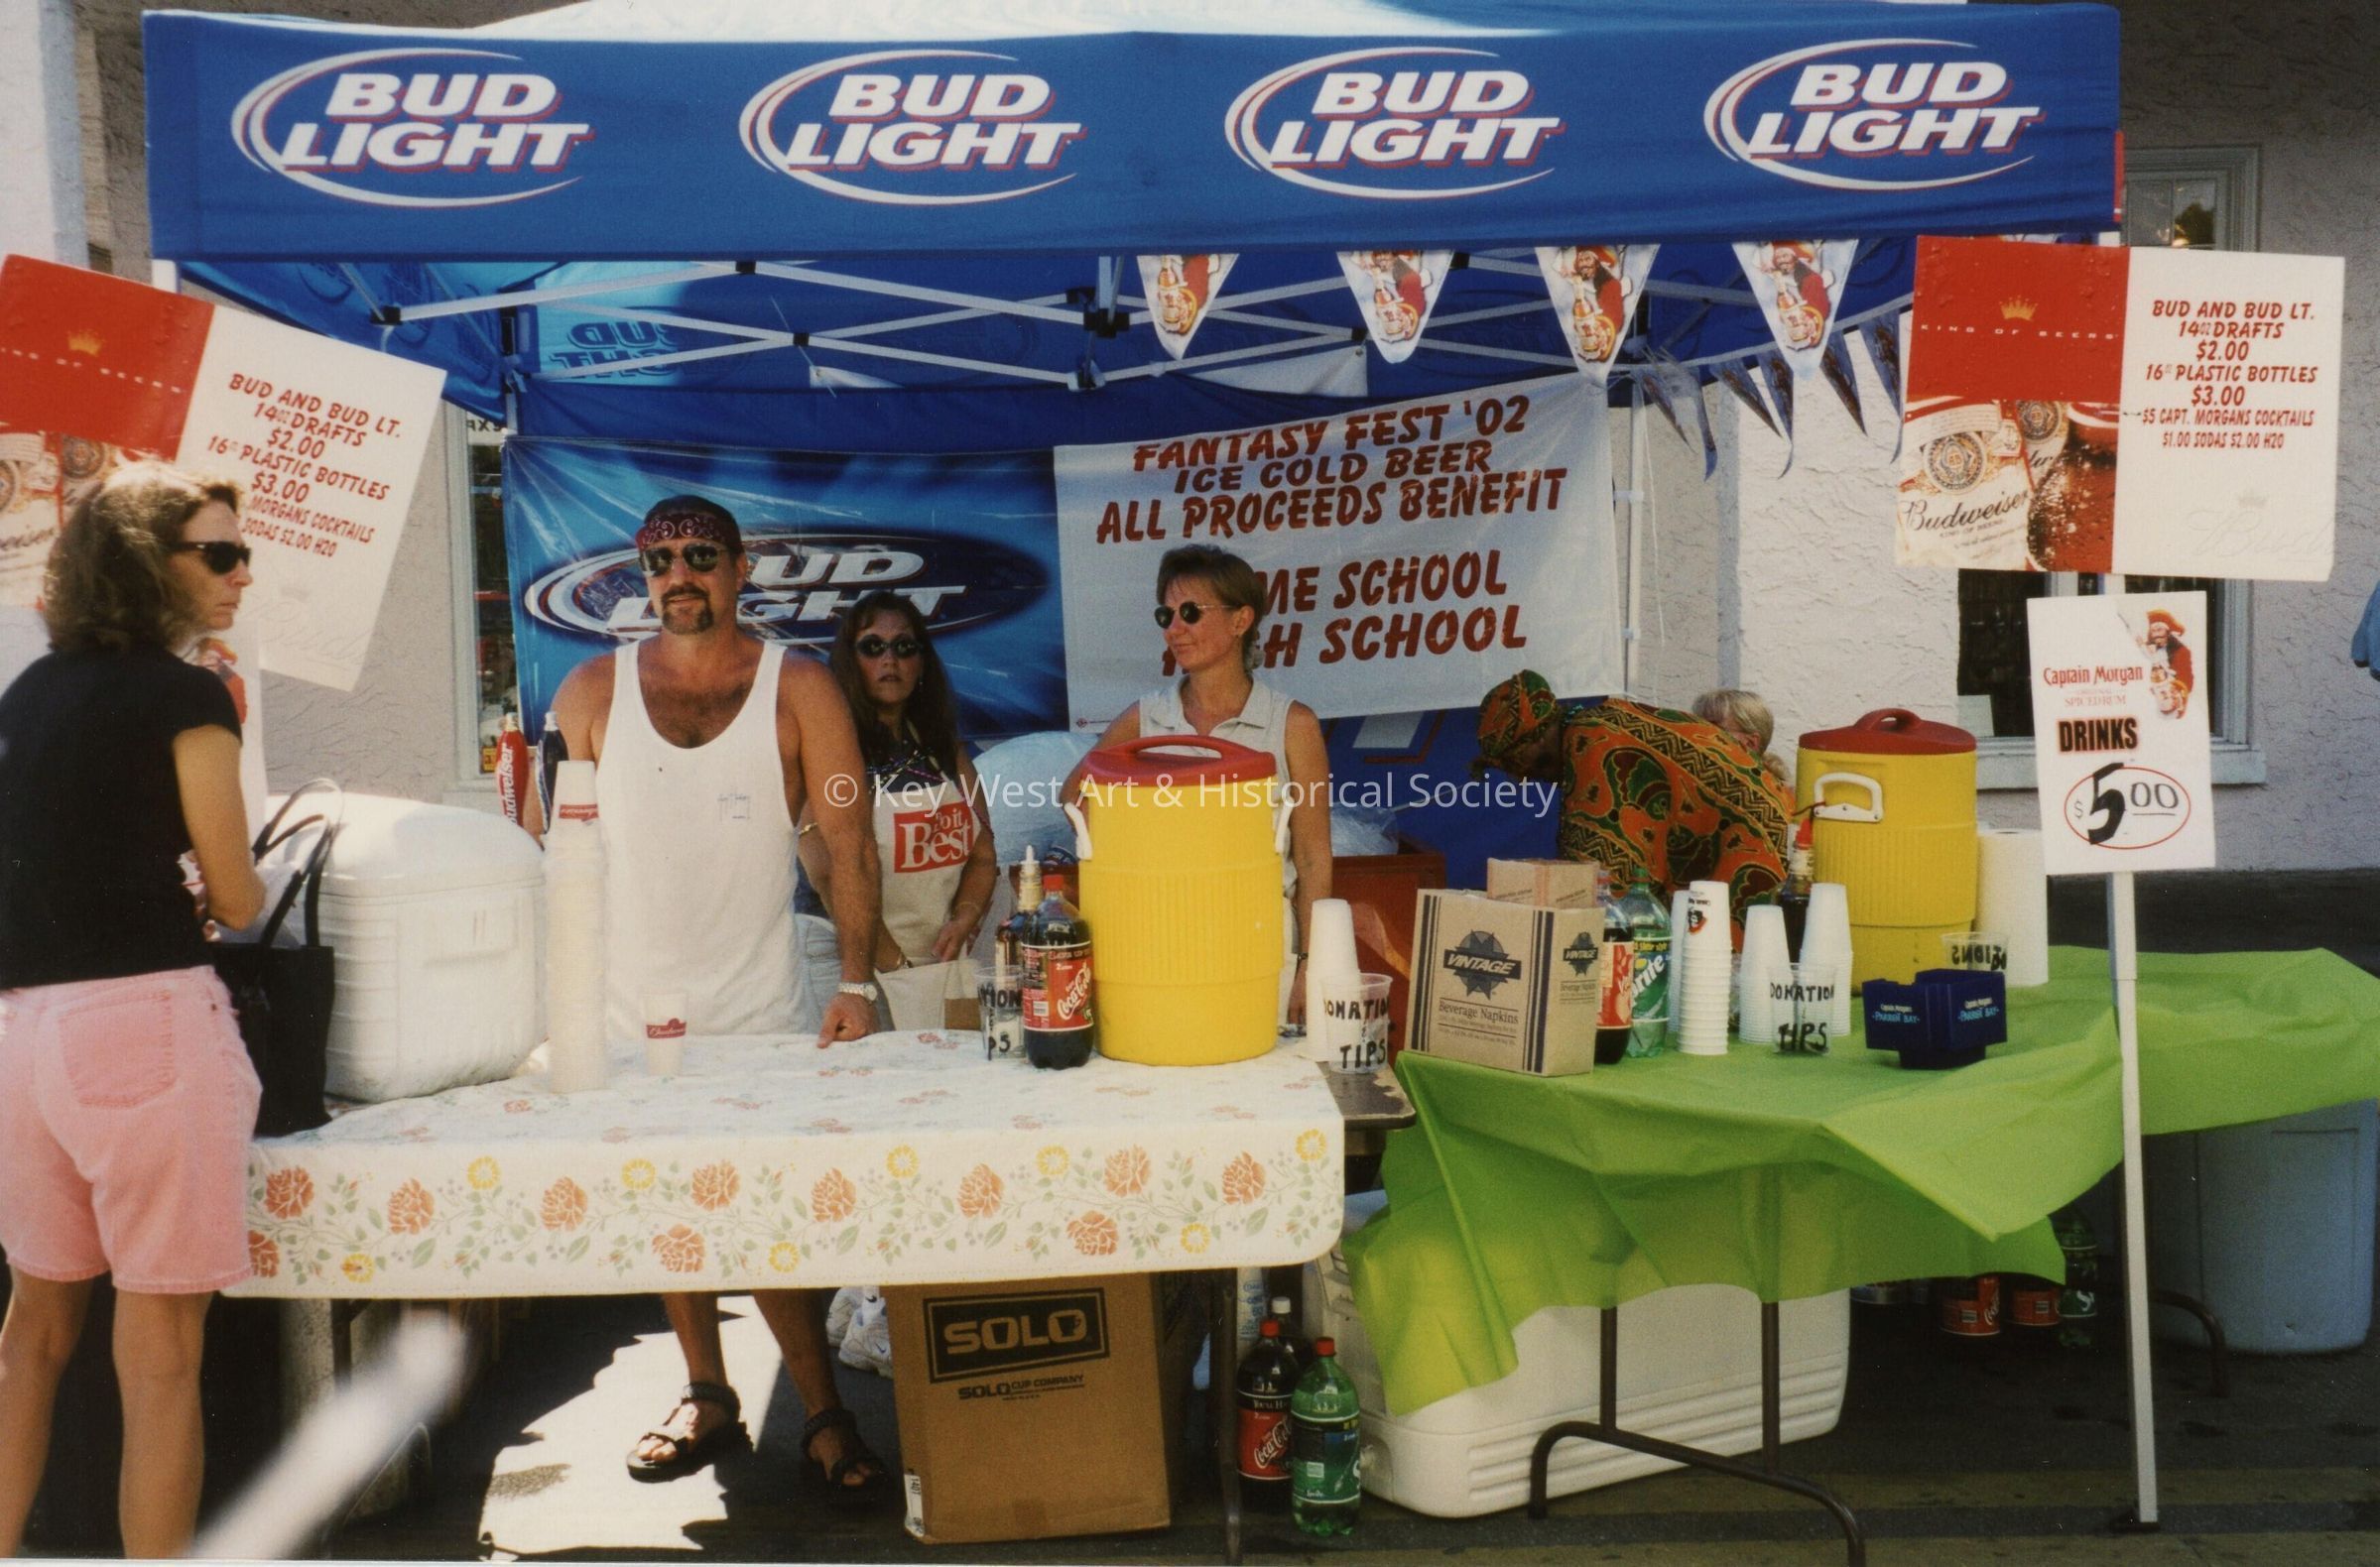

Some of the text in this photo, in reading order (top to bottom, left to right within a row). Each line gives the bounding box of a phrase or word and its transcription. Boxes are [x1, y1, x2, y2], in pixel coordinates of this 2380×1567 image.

[325, 73, 562, 118] BUD
[828, 74, 1054, 119] BUD
[1312, 70, 1533, 118] BUD
[1790, 60, 2012, 108] BUD
[281, 122, 595, 174] LIGHT
[787, 122, 1086, 171] LIGHT
[1270, 117, 1563, 169] LIGHT
[1749, 106, 2046, 160] LIGHT
[2153, 300, 2316, 320] BUD AND BUD LT.
[2213, 321, 2285, 339] DRAFTS
[2195, 339, 2250, 361] $2.00
[2175, 365, 2242, 382] PLASTIC
[2247, 366, 2318, 383] BOTTLES
[2191, 384, 2246, 407] $3.00
[229, 373, 401, 438] BUD AND BUD LT.
[2143, 409, 2315, 426] $5 CAPT. MORGANS COCKTAILS
[267, 426, 325, 460] $2.00
[291, 414, 368, 447] DRAFTS
[1133, 395, 1531, 472] FANTASY FEST '02
[2163, 431, 2191, 448] $1.00
[2193, 432, 2228, 448] SODAS
[2230, 432, 2260, 449] $2.00
[239, 444, 312, 479] PLASTIC
[314, 466, 391, 502] BOTTLES
[250, 471, 311, 505] $3.00
[1174, 439, 1493, 494] ICE COLD BEER
[248, 497, 375, 543] MORGANS COCKTAILS
[1096, 467, 1567, 544] ALL PROCEEDS BENEFIT
[1901, 490, 2028, 532] Budweiser
[744, 549, 926, 588] UD
[1333, 549, 1507, 609] SCHOOL
[606, 585, 968, 632] LGHT
[1319, 605, 1527, 663] SCHOOL
[2043, 665, 2144, 688] Captain Morgan
[2059, 717, 2138, 753] DRINKS
[500, 742, 519, 823] udweiser
[899, 820, 971, 869] Best
[1446, 953, 1515, 976] VINTAGE
[1632, 953, 1666, 1008] prite
[1439, 1000, 1477, 1020] Beverage
[1481, 1008, 1518, 1024] Napkins
[1340, 1038, 1387, 1070] TIPS
[944, 1308, 1088, 1355] SOLO
[958, 1382, 1012, 1400] SOLO
[1033, 1374, 1083, 1387] COMPANY
